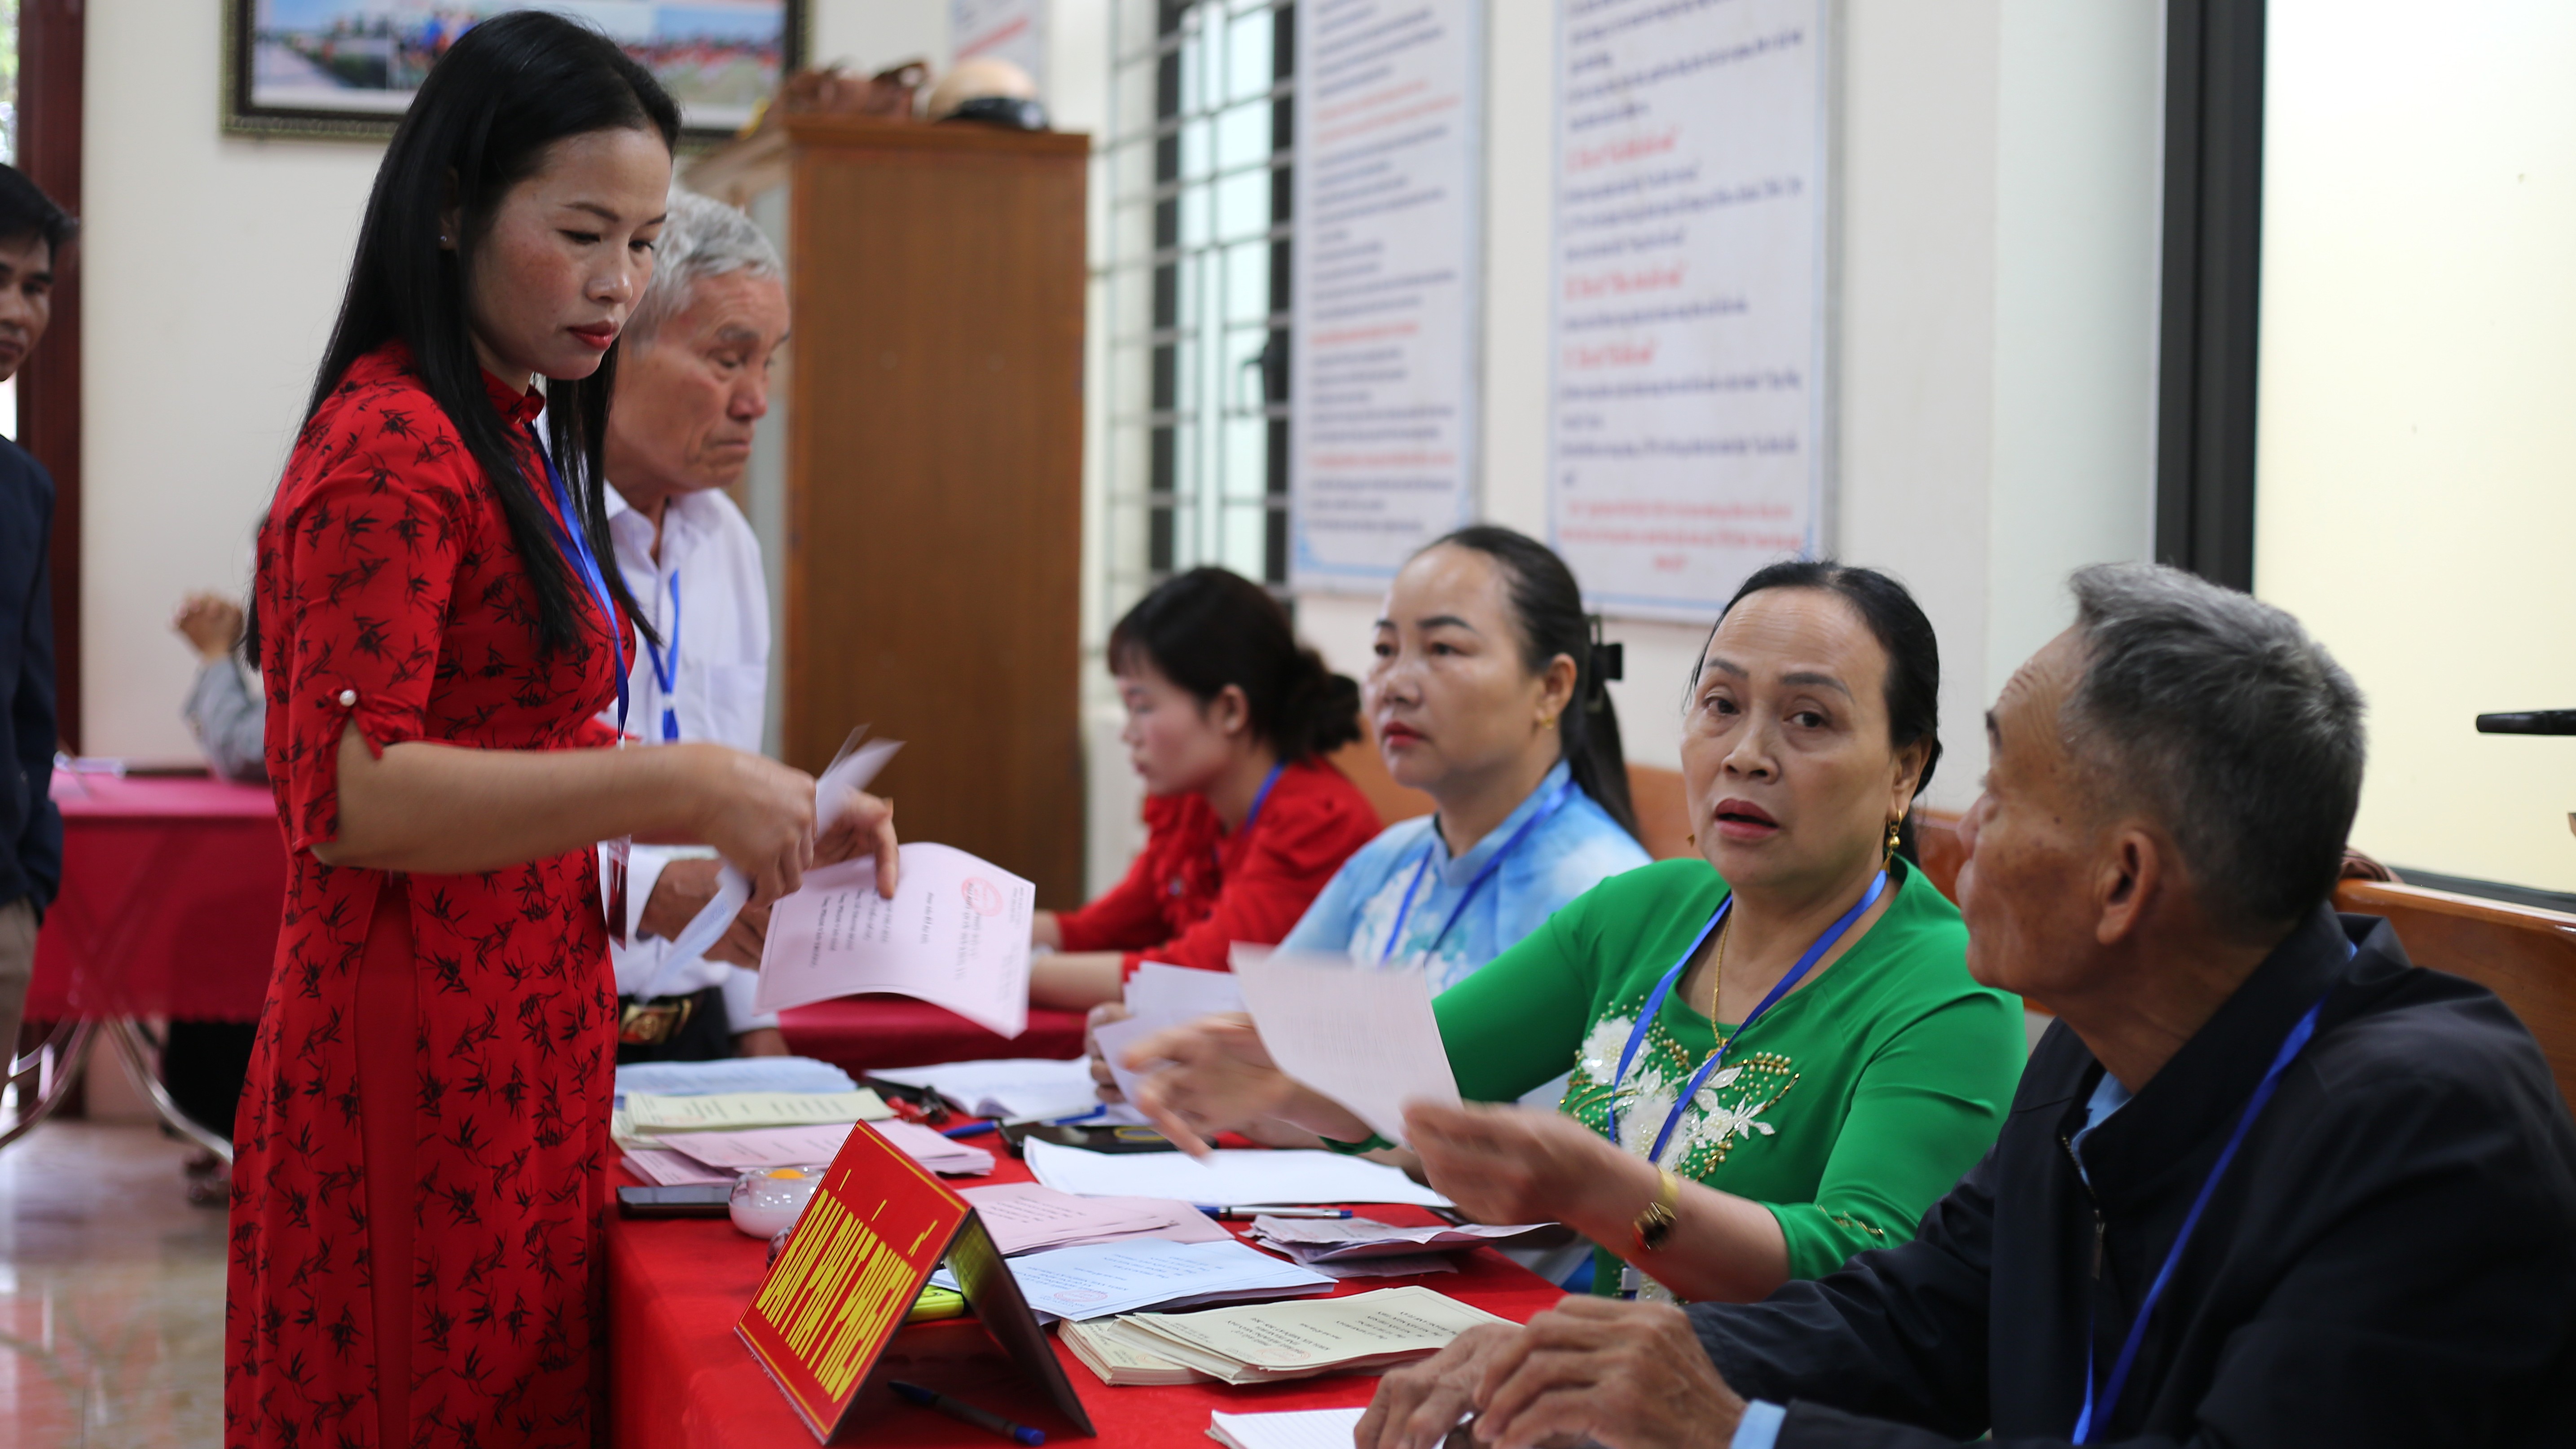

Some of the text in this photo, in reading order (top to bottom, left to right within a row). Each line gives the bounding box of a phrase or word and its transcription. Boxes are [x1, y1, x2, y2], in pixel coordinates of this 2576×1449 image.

[756, 1169, 938, 1403] BÀN PHÁT PHIẾU
